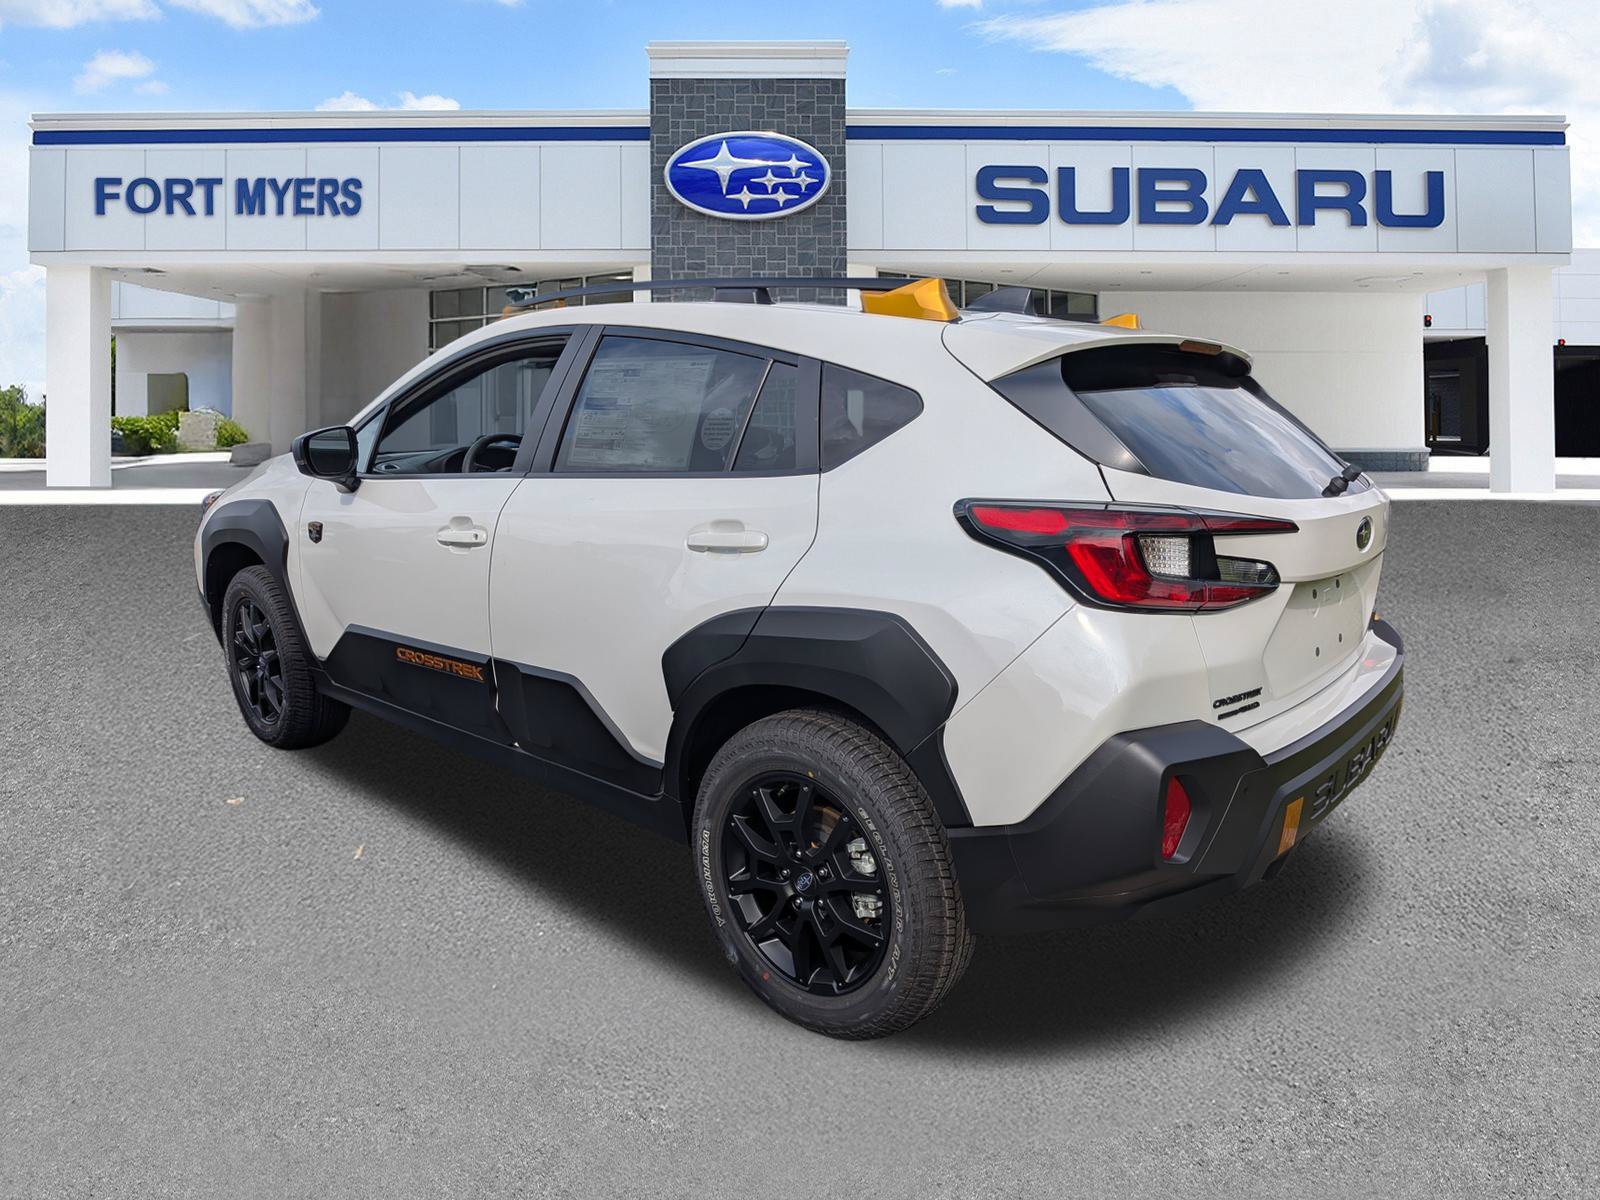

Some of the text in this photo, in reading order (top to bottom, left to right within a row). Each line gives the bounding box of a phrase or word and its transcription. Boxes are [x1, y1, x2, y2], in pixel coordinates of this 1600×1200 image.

[95, 177, 362, 216] FORT MYERS
[976, 165, 1444, 228] SUBARU
[396, 647, 484, 681] CROSSTREK
[701, 829, 725, 928] YOKOHAMA
